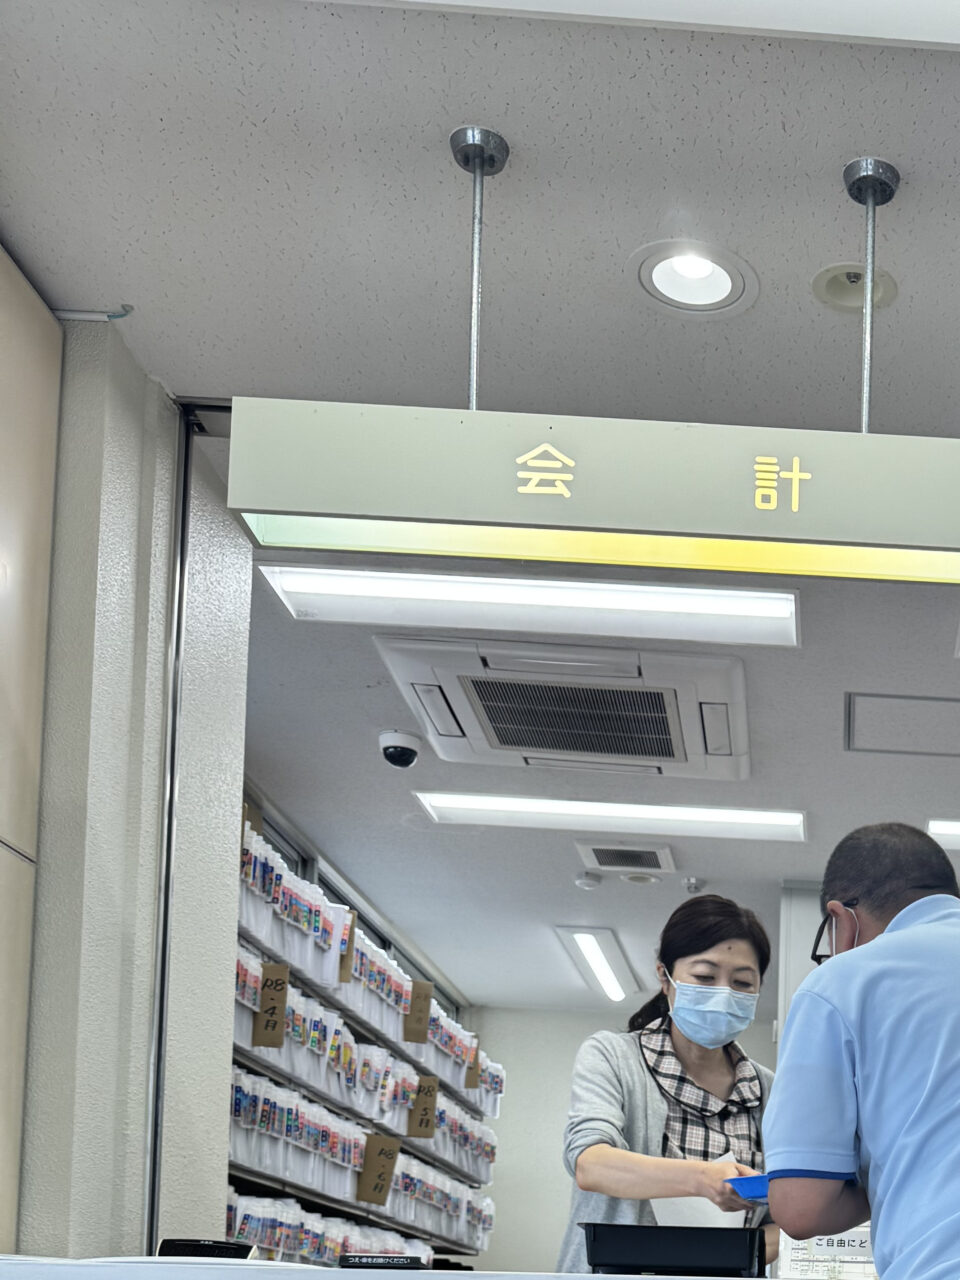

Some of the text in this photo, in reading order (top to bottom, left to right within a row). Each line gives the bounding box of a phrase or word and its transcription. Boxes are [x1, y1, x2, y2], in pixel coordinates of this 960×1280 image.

[516, 442, 812, 514] 会計
[815, 1237, 868, 1248] ご自由にど
